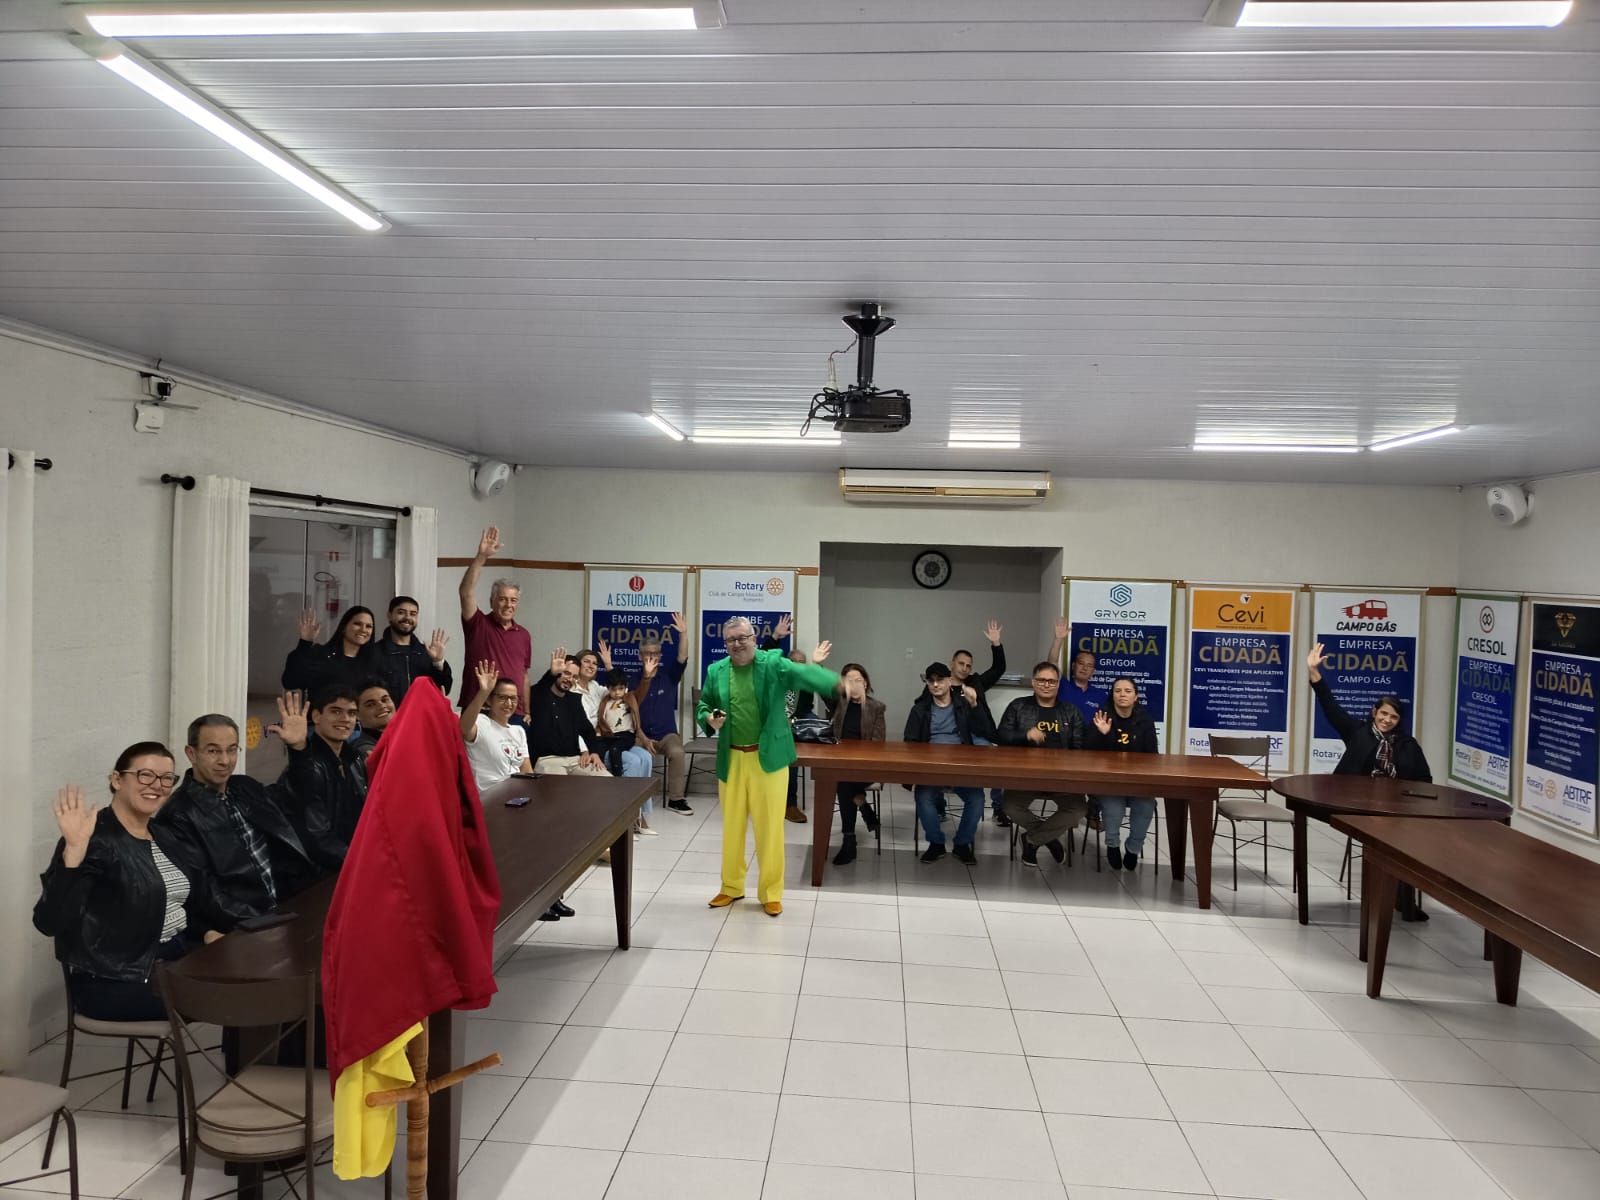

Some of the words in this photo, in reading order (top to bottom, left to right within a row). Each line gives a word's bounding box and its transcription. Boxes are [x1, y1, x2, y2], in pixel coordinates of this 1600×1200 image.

[735, 581, 764, 592] Rotary
[607, 593, 613, 606] A
[616, 593, 667, 607] ESTUDANTIL
[612, 614, 660, 625] EMPRESA
[1094, 609, 1147, 619] GRYGOR
[1217, 603, 1265, 624] Cevi
[1094, 628, 1145, 639] EMPRESA
[1336, 621, 1374, 632] CAMPO
[1375, 621, 1398, 633] GÁS
[1078, 635, 1160, 656] CIDADÃ
[1215, 637, 1267, 648] EMPRESA
[1339, 639, 1393, 651] EMPRESA
[1467, 636, 1507, 656] CRESOL
[1199, 644, 1282, 665] CIDADÃ
[1322, 650, 1409, 672] CIDADÃ
[1099, 658, 1137, 668] GRYGOR
[1468, 659, 1504, 675] EMPRESA
[1545, 660, 1582, 676] EMPRESA
[1207, 667, 1240, 675] TRANSPORTE
[1337, 675, 1371, 684] CAMPO
[1373, 674, 1392, 685] GÁS
[1461, 669, 1513, 693] CIDADÃ
[1535, 670, 1595, 699] CIDADÃ
[1471, 690, 1498, 705] CRESOL
[1037, 719, 1060, 734] evi
[1312, 748, 1343, 760] Rotary
[1487, 755, 1509, 772] ABTRF
[1562, 784, 1593, 805] ABTRF
